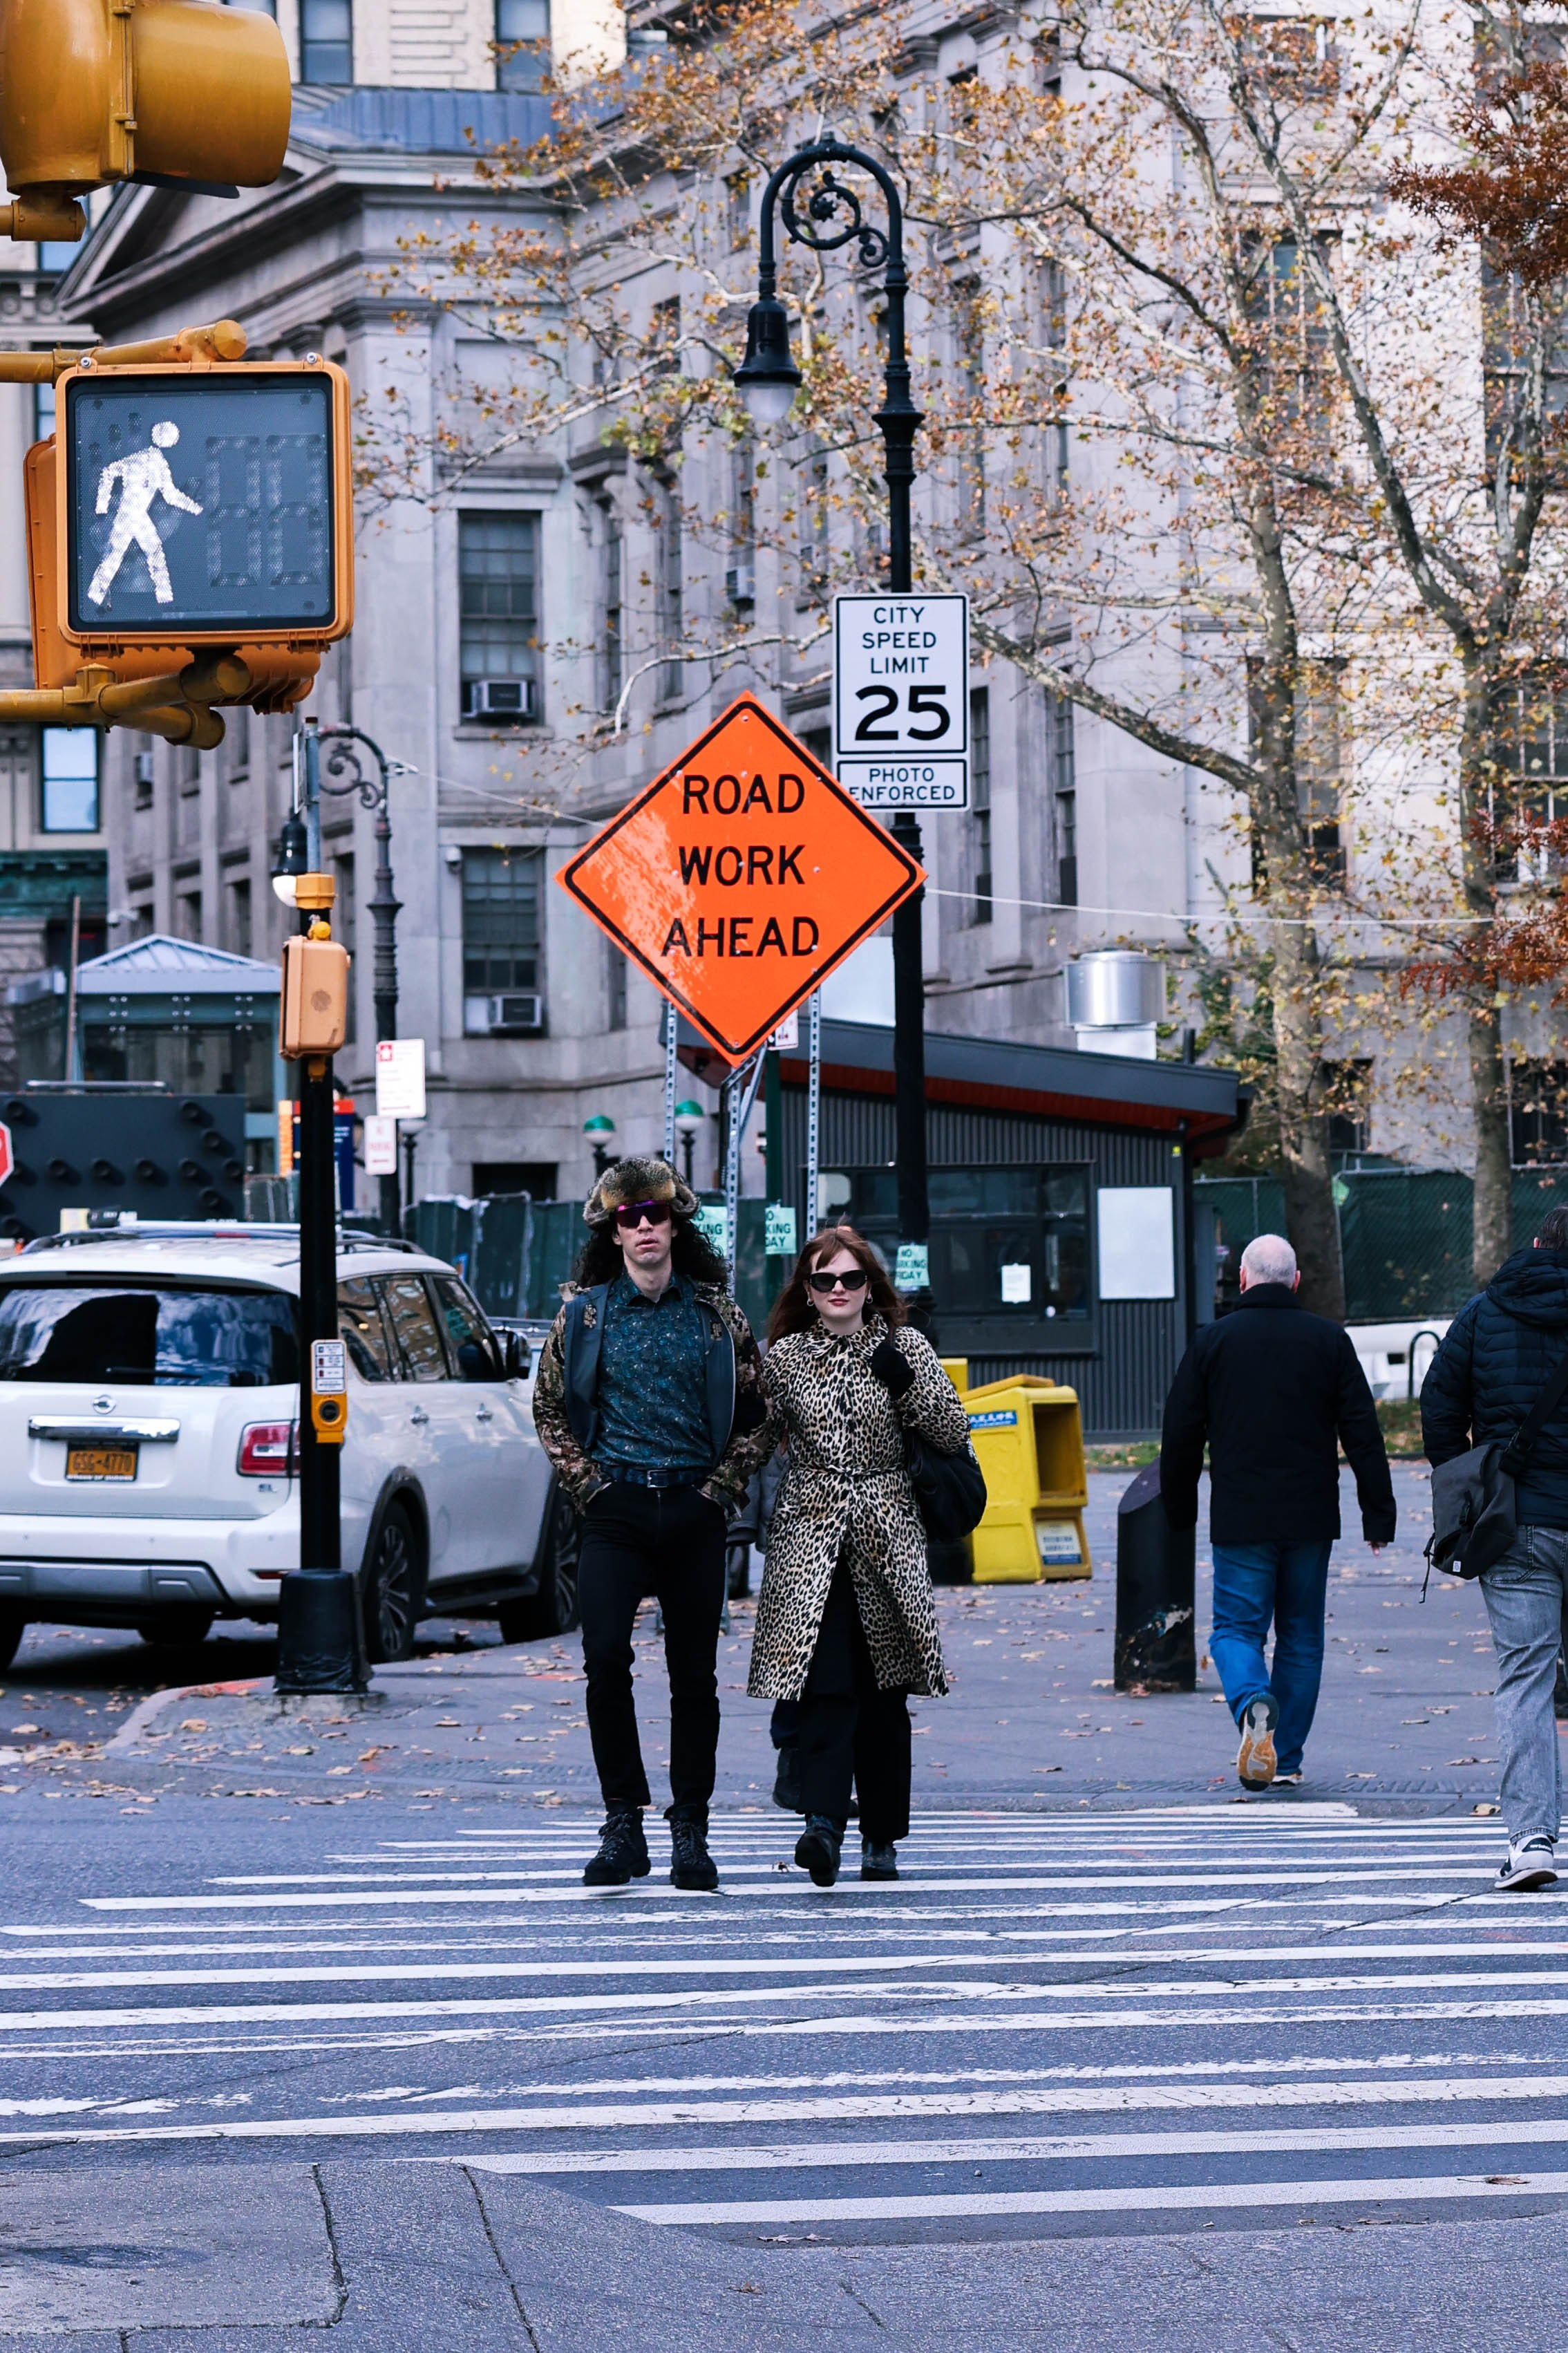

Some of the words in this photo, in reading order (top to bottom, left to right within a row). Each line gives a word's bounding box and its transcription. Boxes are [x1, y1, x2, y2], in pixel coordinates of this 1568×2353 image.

[873, 607, 925, 624] CITY
[862, 632, 936, 648] SPEED
[871, 657, 929, 673] LIMIT
[855, 685, 950, 741] 25
[869, 767, 934, 782] PHOTO
[683, 774, 805, 814] ROAD
[849, 785, 955, 801] ENFORCED
[679, 844, 806, 887] WORK
[661, 916, 820, 957] AHEAD
